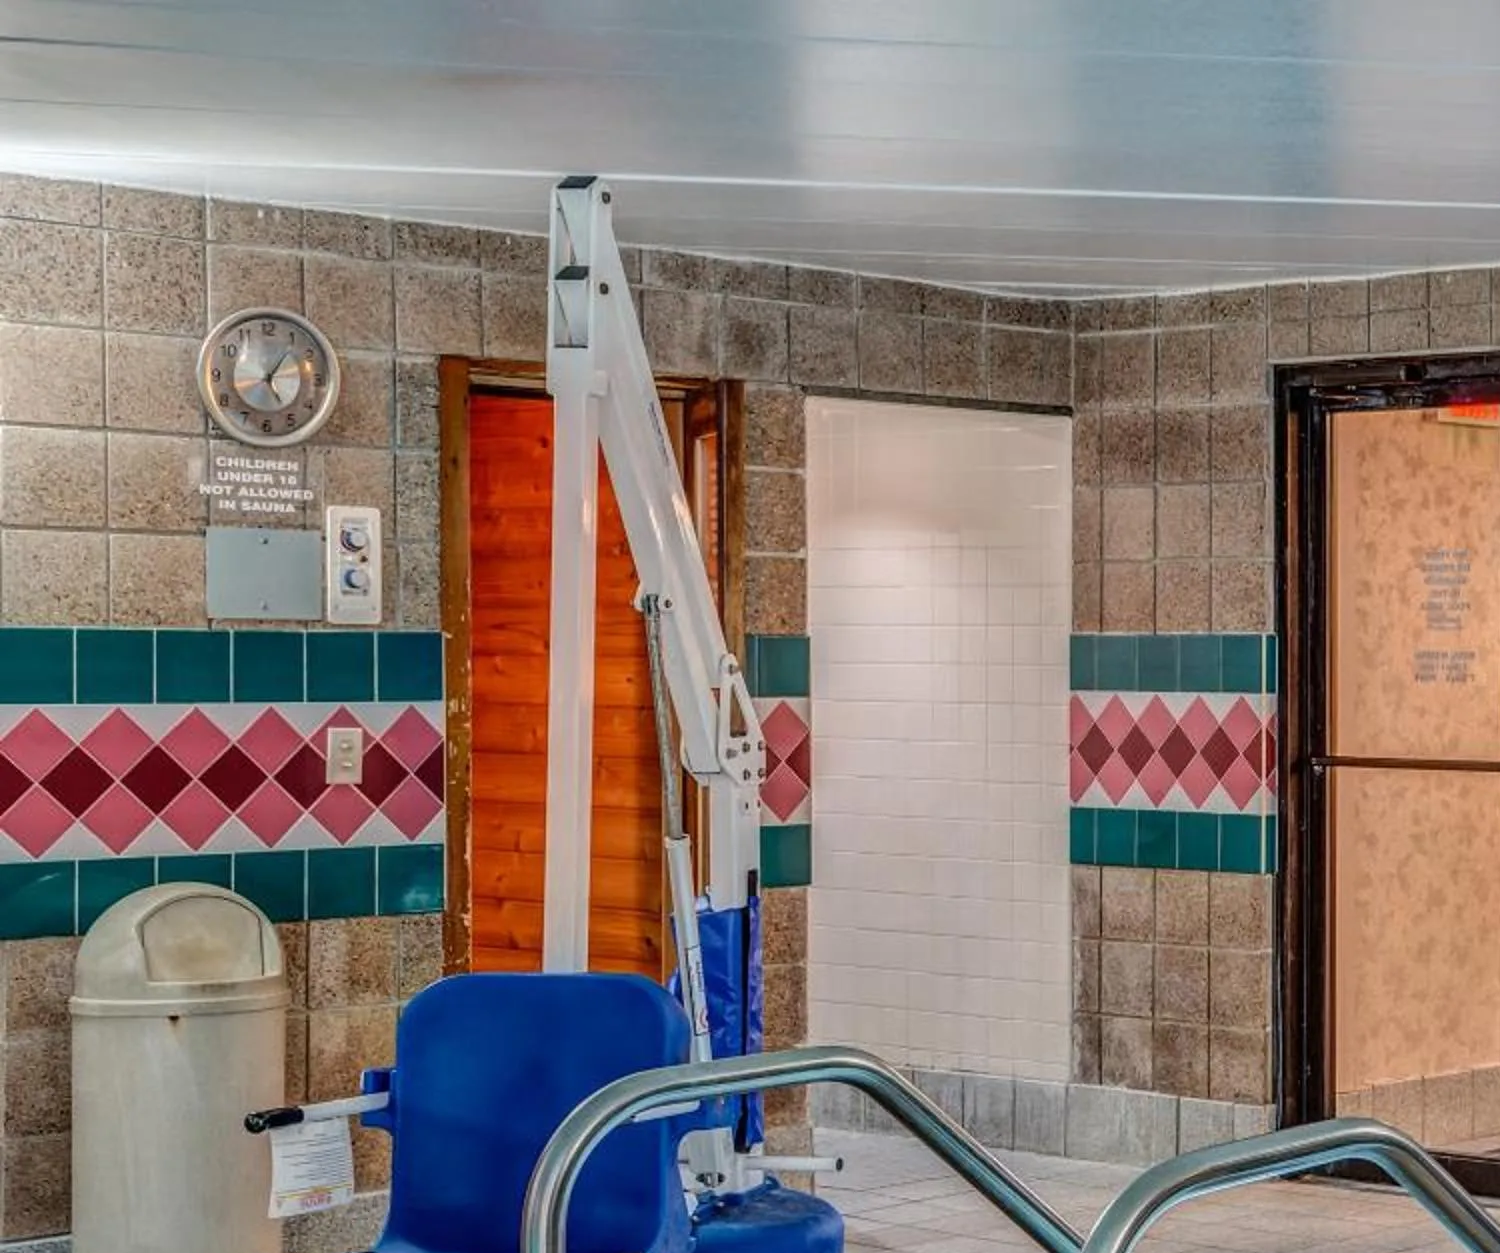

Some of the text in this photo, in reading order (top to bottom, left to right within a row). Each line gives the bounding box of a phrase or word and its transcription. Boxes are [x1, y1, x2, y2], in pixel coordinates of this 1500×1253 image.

[262, 322, 275, 336] 12
[221, 344, 237, 358] 10
[215, 456, 299, 471] CHILDREN
[217, 471, 273, 484] UNDER
[200, 483, 314, 500] NOT ALLOWED
[219, 499, 296, 513] IN SAUNA
